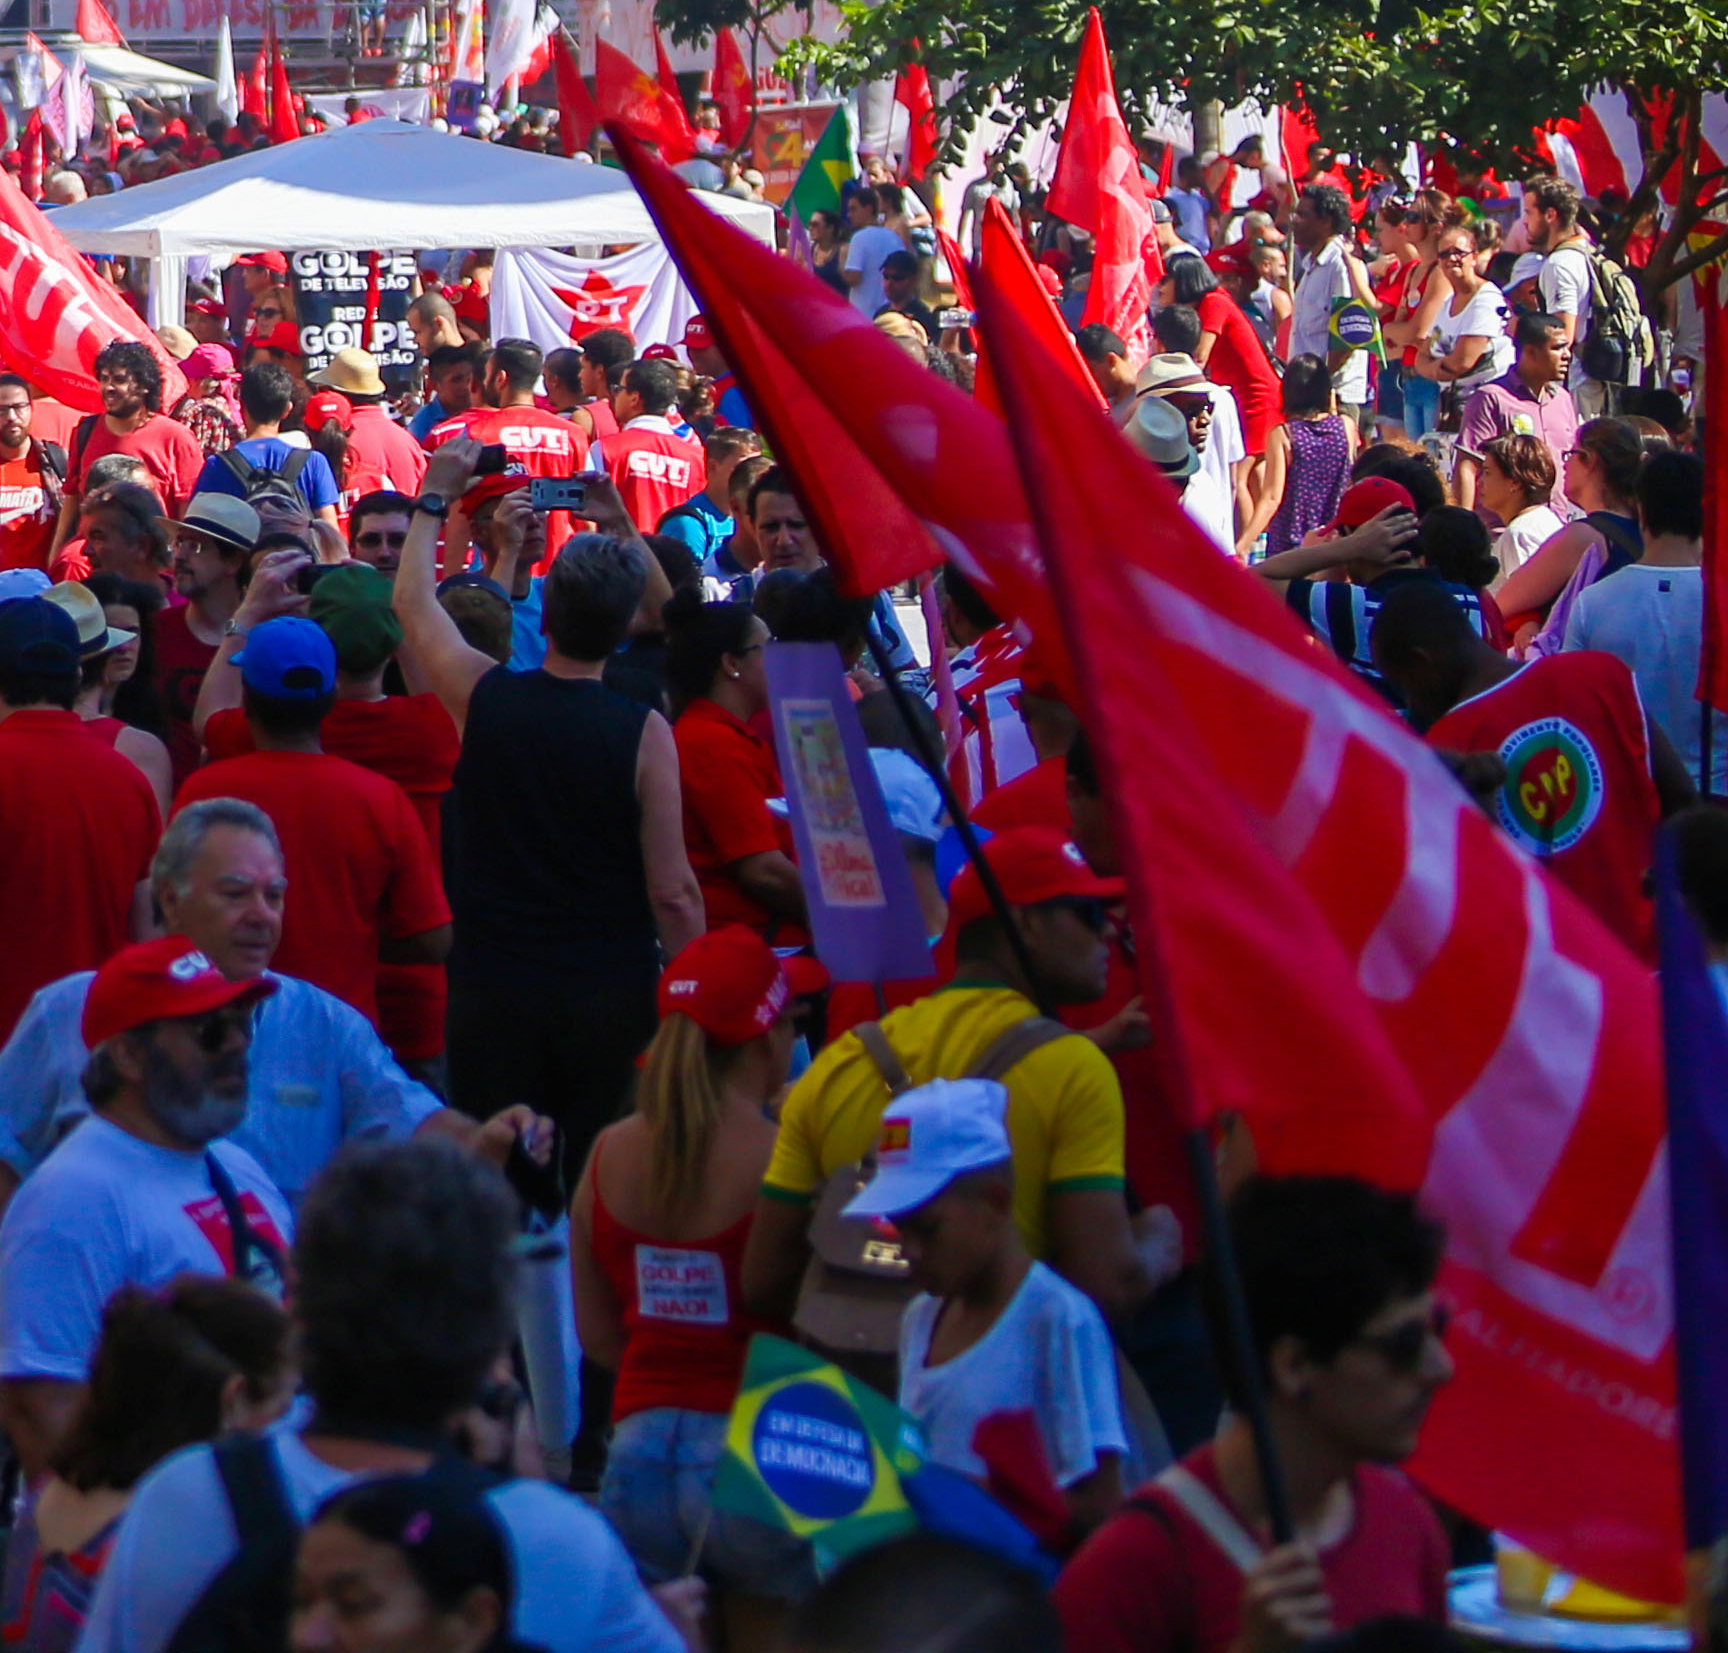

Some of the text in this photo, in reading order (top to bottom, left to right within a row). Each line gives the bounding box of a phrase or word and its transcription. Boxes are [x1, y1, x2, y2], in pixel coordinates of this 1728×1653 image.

[300, 272, 410, 292] DE TELEVSÃO
[575, 296, 630, 324] PT
[499, 426, 563, 448] CUT
[628, 450, 687, 482] CUT
